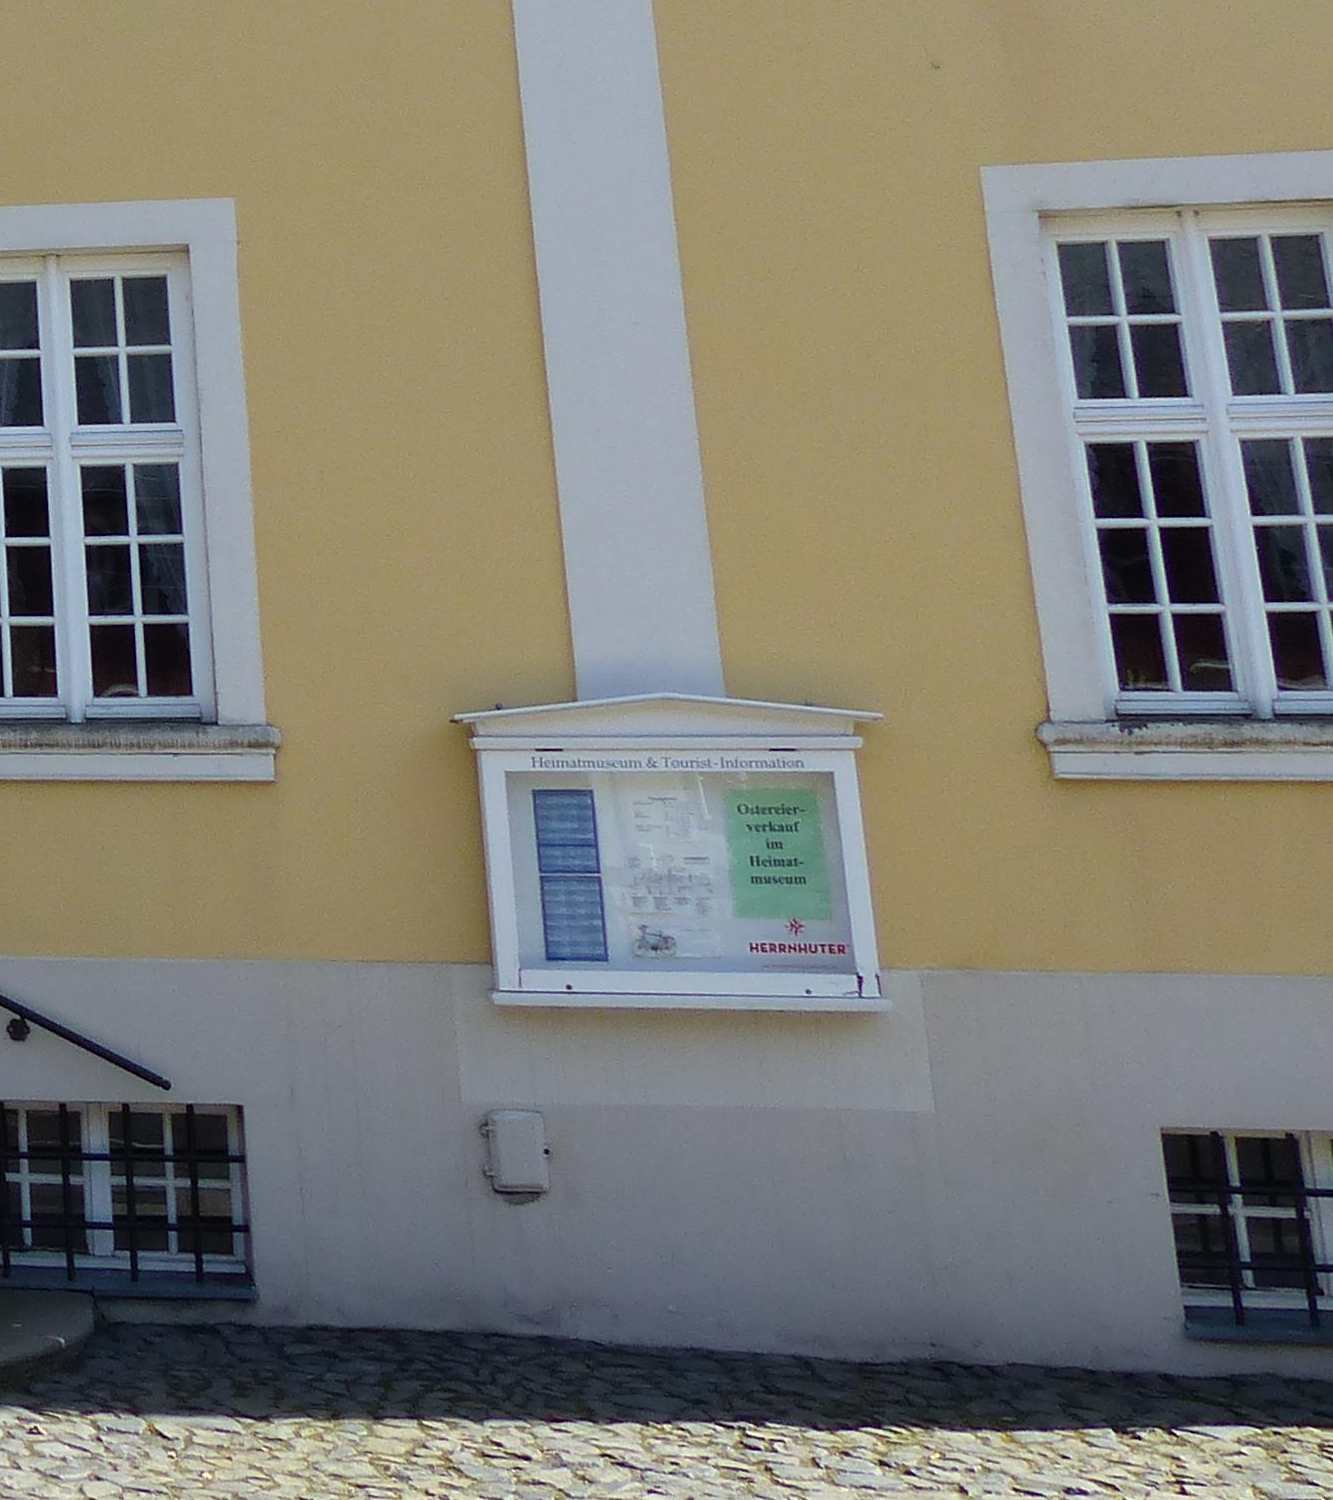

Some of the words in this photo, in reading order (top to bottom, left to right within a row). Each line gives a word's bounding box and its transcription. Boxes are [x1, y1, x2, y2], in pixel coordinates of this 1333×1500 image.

[531, 756, 643, 770] Heimatmuseum
[646, 756, 659, 770] &
[661, 756, 805, 770] Tourist-Information
[737, 803, 805, 816] Ostereier-
[746, 819, 800, 833] verkauf
[766, 838, 784, 850] im
[749, 855, 804, 868] Heimat-
[750, 874, 807, 885] museum
[749, 942, 846, 955] HERRNHUTER
